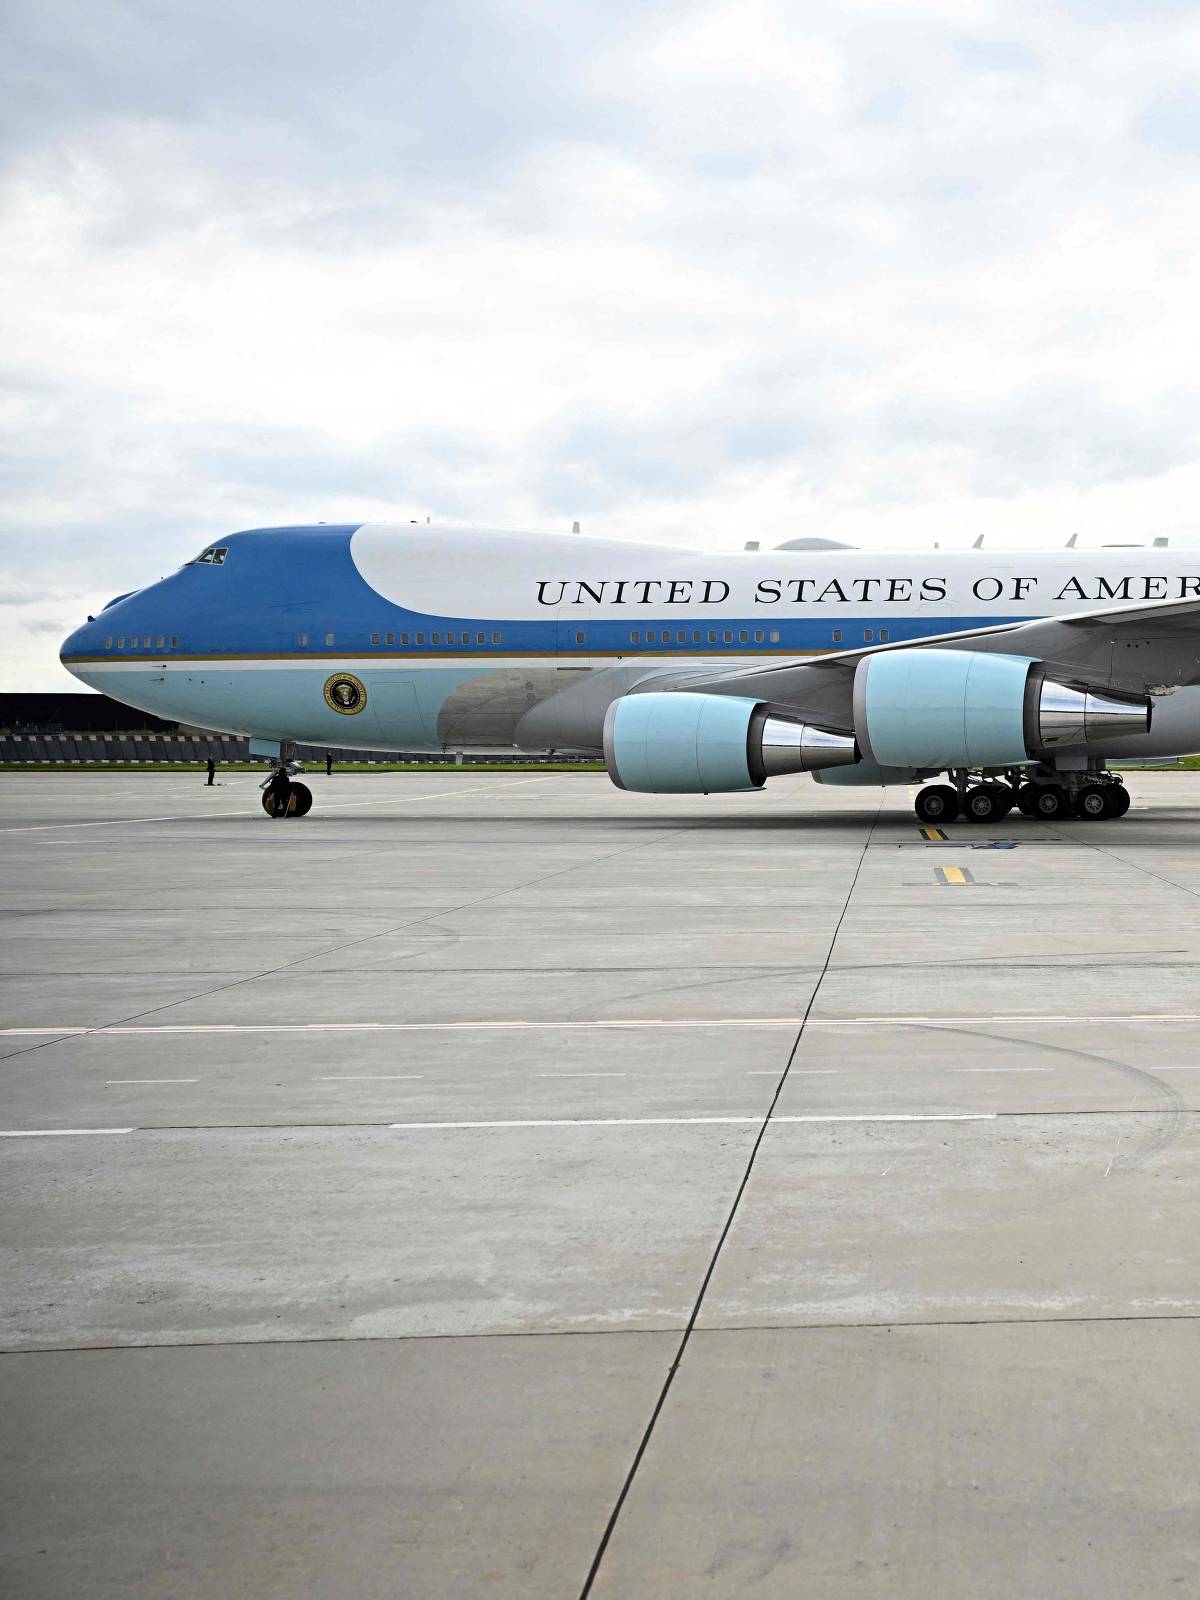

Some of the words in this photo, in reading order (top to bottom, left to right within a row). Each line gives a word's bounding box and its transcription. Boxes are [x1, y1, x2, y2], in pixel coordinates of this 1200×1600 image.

[535, 580, 730, 606] UNITED
[754, 577, 947, 604] STATES
[972, 577, 1038, 602] OF
